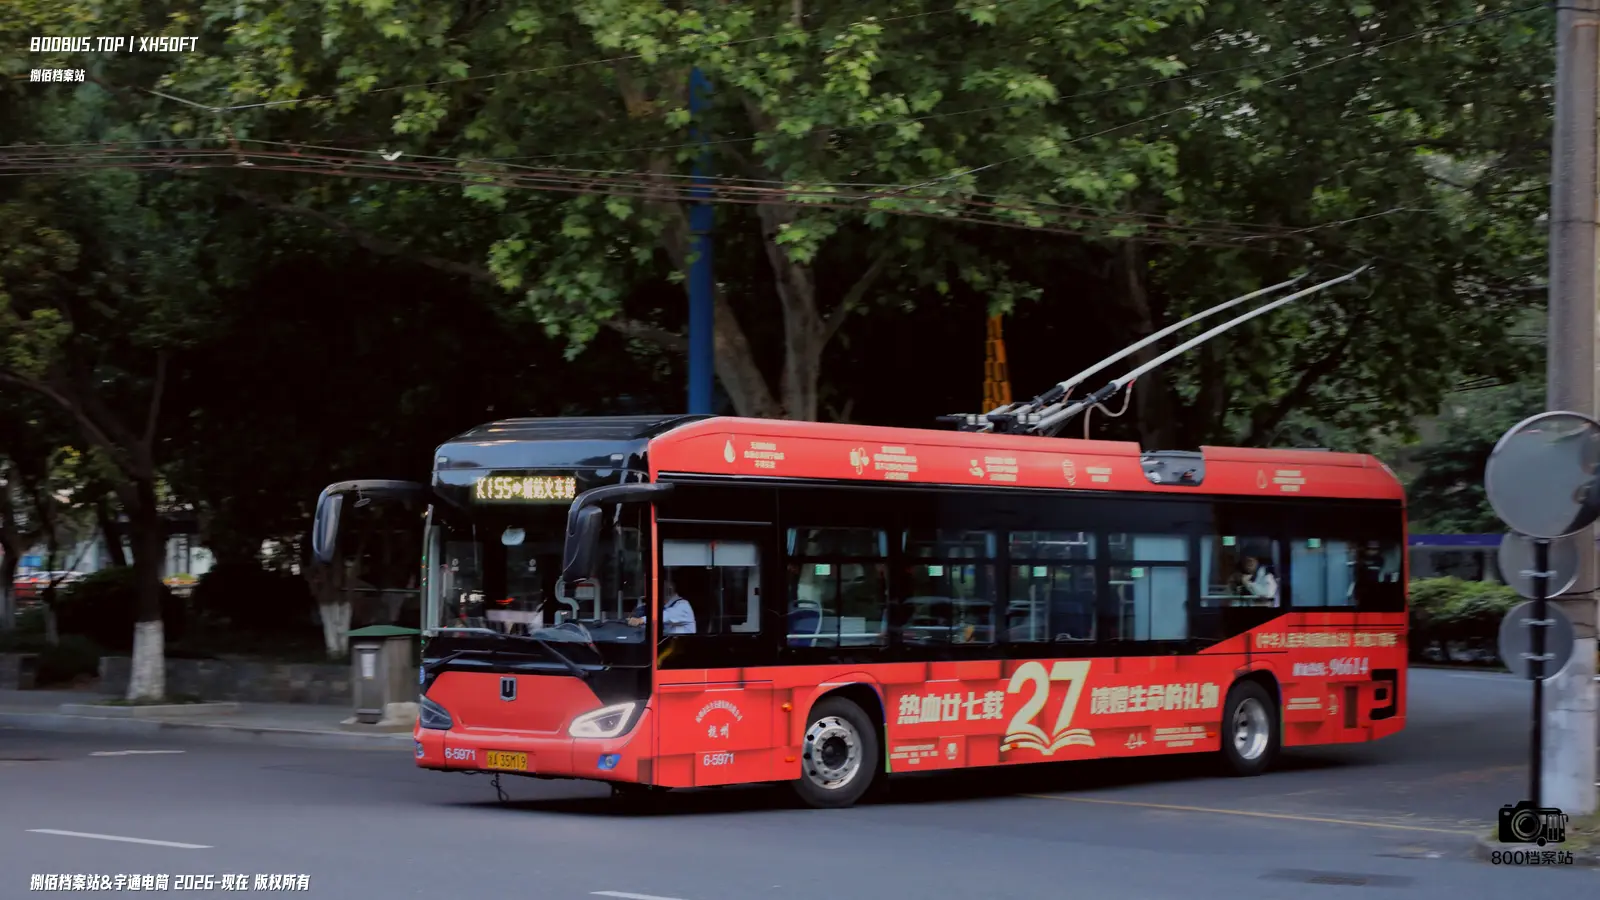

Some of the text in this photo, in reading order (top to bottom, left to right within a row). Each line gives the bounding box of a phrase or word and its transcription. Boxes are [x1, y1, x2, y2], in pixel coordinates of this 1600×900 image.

[897, 690, 1004, 725] 热血廿七载
[1005, 661, 1091, 745] 27
[445, 747, 476, 761] 6-5971
[703, 752, 735, 767] 6-5971
